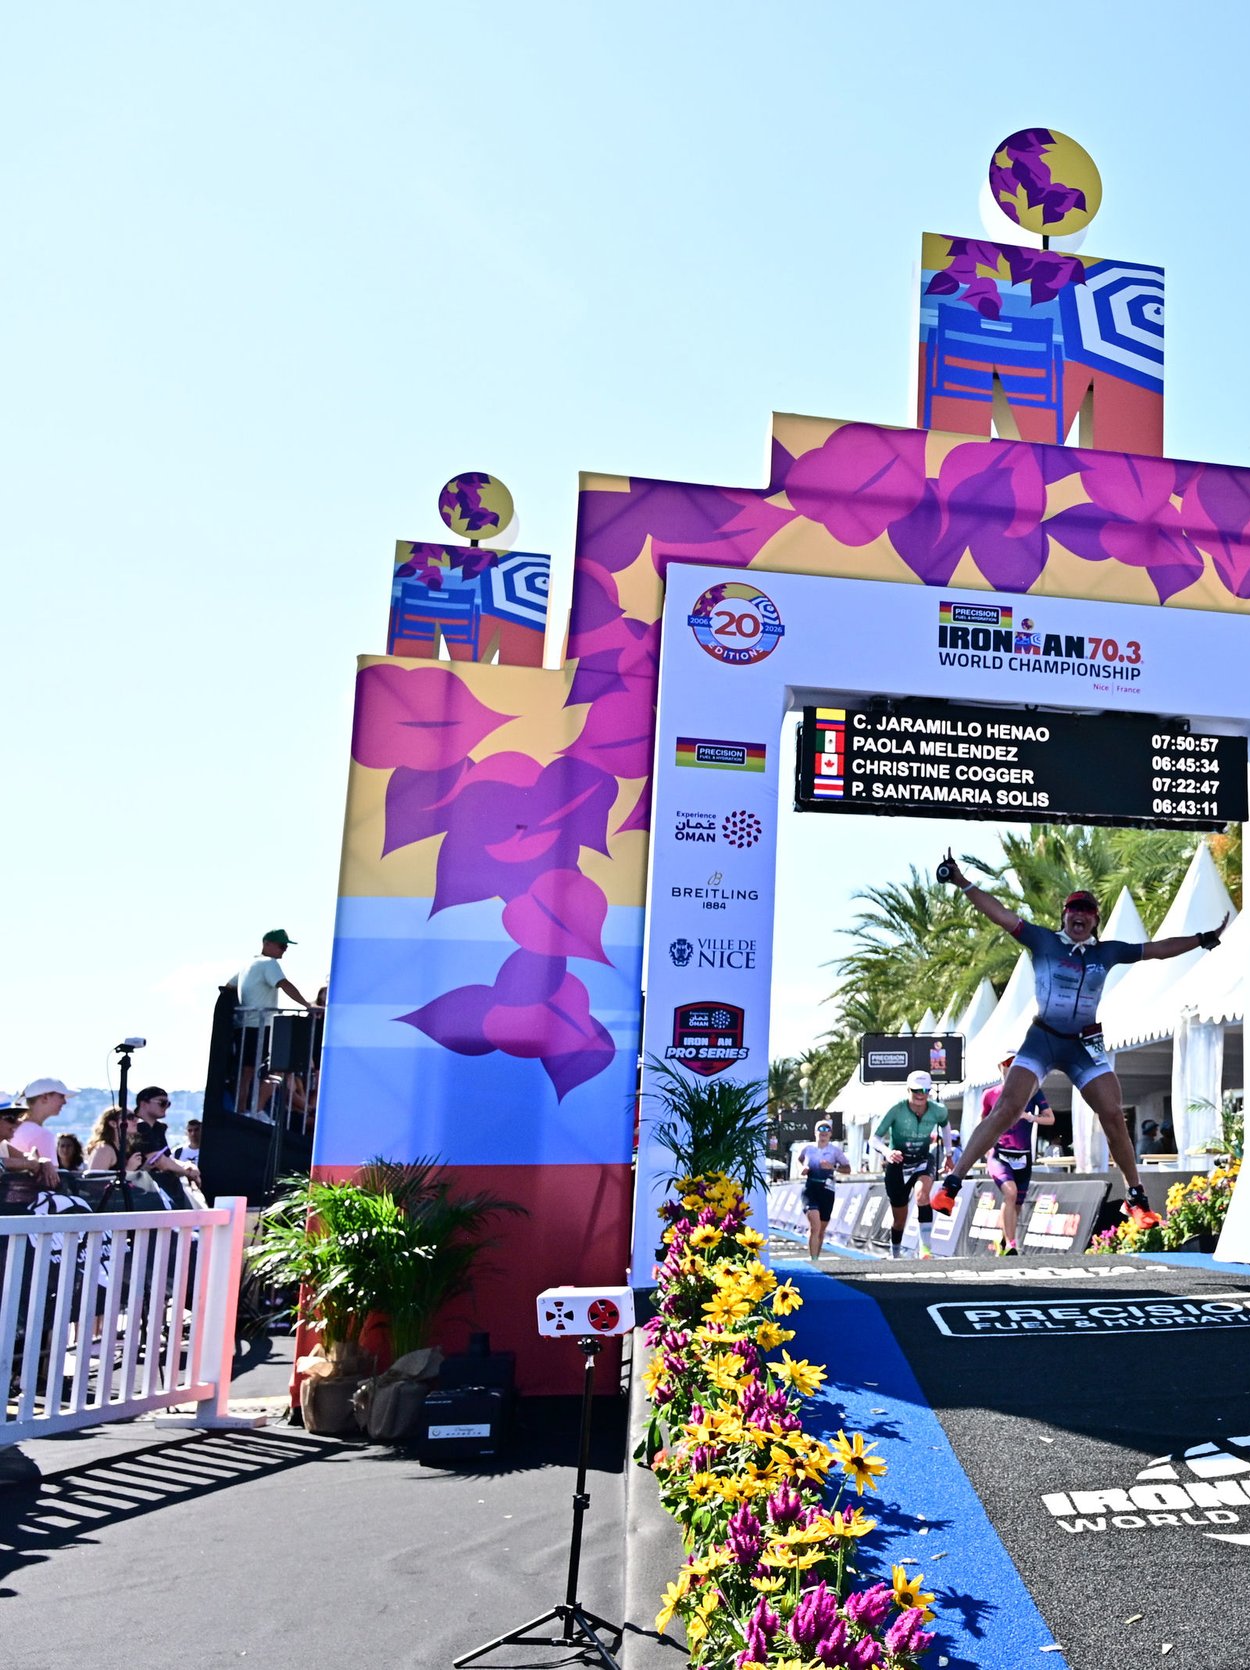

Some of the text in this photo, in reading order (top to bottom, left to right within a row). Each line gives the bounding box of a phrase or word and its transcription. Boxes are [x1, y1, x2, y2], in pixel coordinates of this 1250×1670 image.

[955, 608, 998, 618] PRECISION
[714, 611, 761, 638] 20
[708, 641, 764, 660] EDITIONS
[939, 652, 1141, 681] WORLD CHAMPIONSHIP
[1093, 683, 1141, 694] Nice France
[853, 714, 1050, 742] C. JARAMILLO HENAO
[853, 736, 1018, 761] PAOLA MELENDEZ
[1151, 735, 1219, 752] 07:50:57
[699, 748, 743, 757] PRECISION
[852, 759, 1035, 784] CHRISTINE COGGER
[1152, 756, 1220, 773] 06:45:34
[852, 781, 1050, 807] P. SANTAMARIA SOLIS
[1152, 777, 1220, 794] 07:22:47
[676, 811, 717, 819] Experience
[1152, 799, 1218, 816] 06:43:11
[675, 831, 716, 843] OMAN
[672, 887, 759, 900] BREITLING
[702, 901, 726, 910] 1884
[698, 938, 756, 950] VILLE DE
[698, 951, 756, 969] NICE
[666, 1047, 748, 1058] PRO SERIES
[973, 1321, 1066, 1331] FUEL
[1075, 1320, 1101, 1328] &
[1056, 1506, 1240, 1533] WORLD
